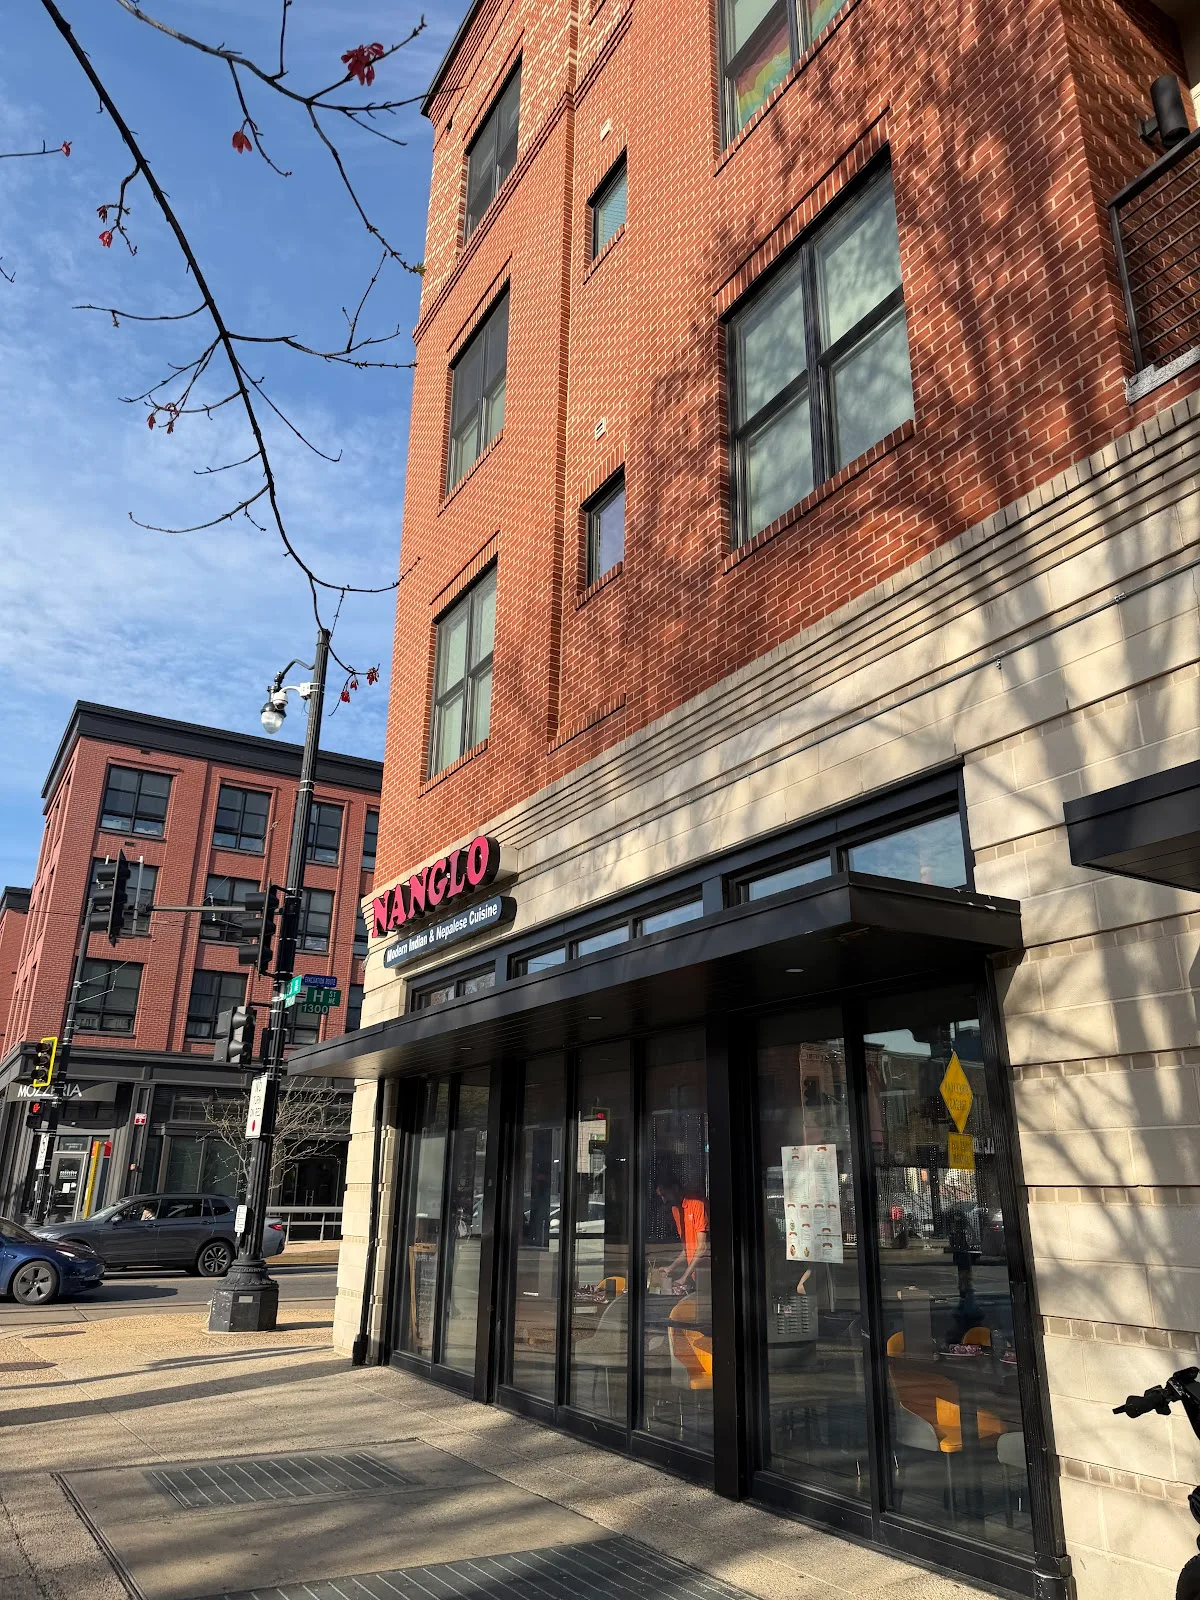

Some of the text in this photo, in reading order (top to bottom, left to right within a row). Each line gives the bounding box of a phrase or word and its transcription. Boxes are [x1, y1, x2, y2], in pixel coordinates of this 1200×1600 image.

[372, 836, 490, 938] NANGLO
[386, 903, 498, 963] Modern Indian & Nepalese Cuisine
[313, 989, 325, 1003] H
[328, 990, 337, 998] ST
[328, 997, 336, 1005] NE
[303, 1003, 329, 1015] 1300
